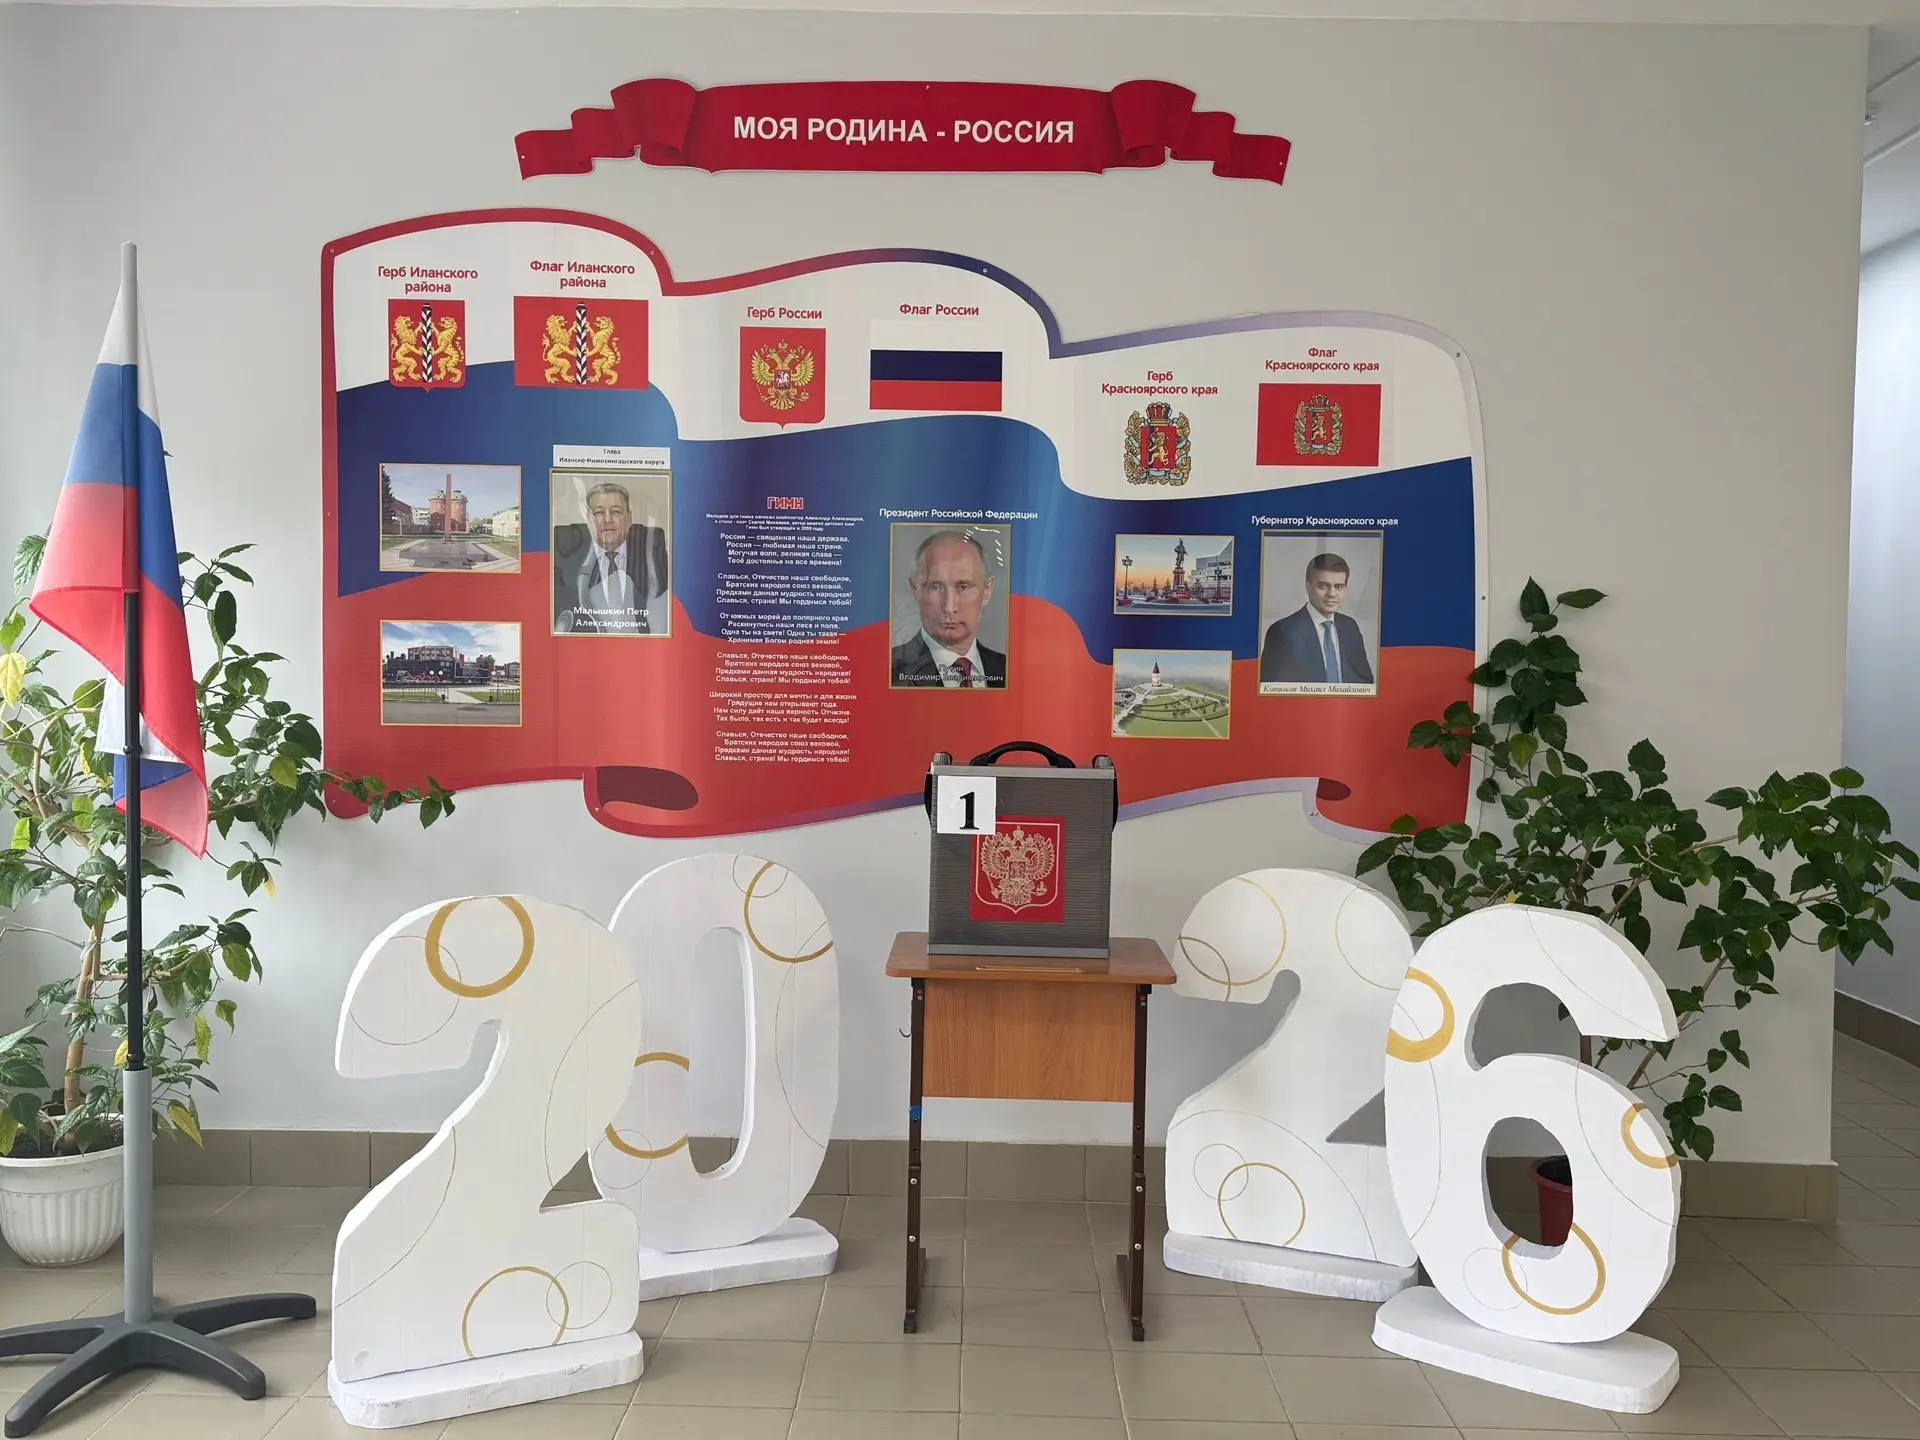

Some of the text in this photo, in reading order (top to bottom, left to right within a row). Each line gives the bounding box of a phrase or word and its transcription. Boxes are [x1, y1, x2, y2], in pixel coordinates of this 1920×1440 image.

[732, 116, 798, 141] МОЯ
[807, 117, 928, 147] РОДИНА
[953, 119, 1075, 145] РОССИЯ
[378, 266, 478, 280] Герб Иланского
[530, 260, 635, 275] Флаг Иланского
[404, 281, 451, 294] района
[560, 276, 607, 290] района
[747, 306, 823, 320] Герб России
[899, 303, 979, 316] Флаг России
[1308, 347, 1337, 359] Флаг
[1265, 360, 1380, 373] Красноярского края
[1147, 371, 1173, 383] Герб
[1101, 383, 1218, 396] Красноярского края
[767, 496, 804, 510] ГИМН
[879, 508, 1038, 520] Президент Российской Федерации
[1251, 515, 1399, 527] Губернатор Красноярского края
[573, 606, 649, 618] Малышкин Петр
[575, 619, 647, 629] Александрович
[899, 673, 941, 682] Владимир
[959, 791, 980, 831] 1
